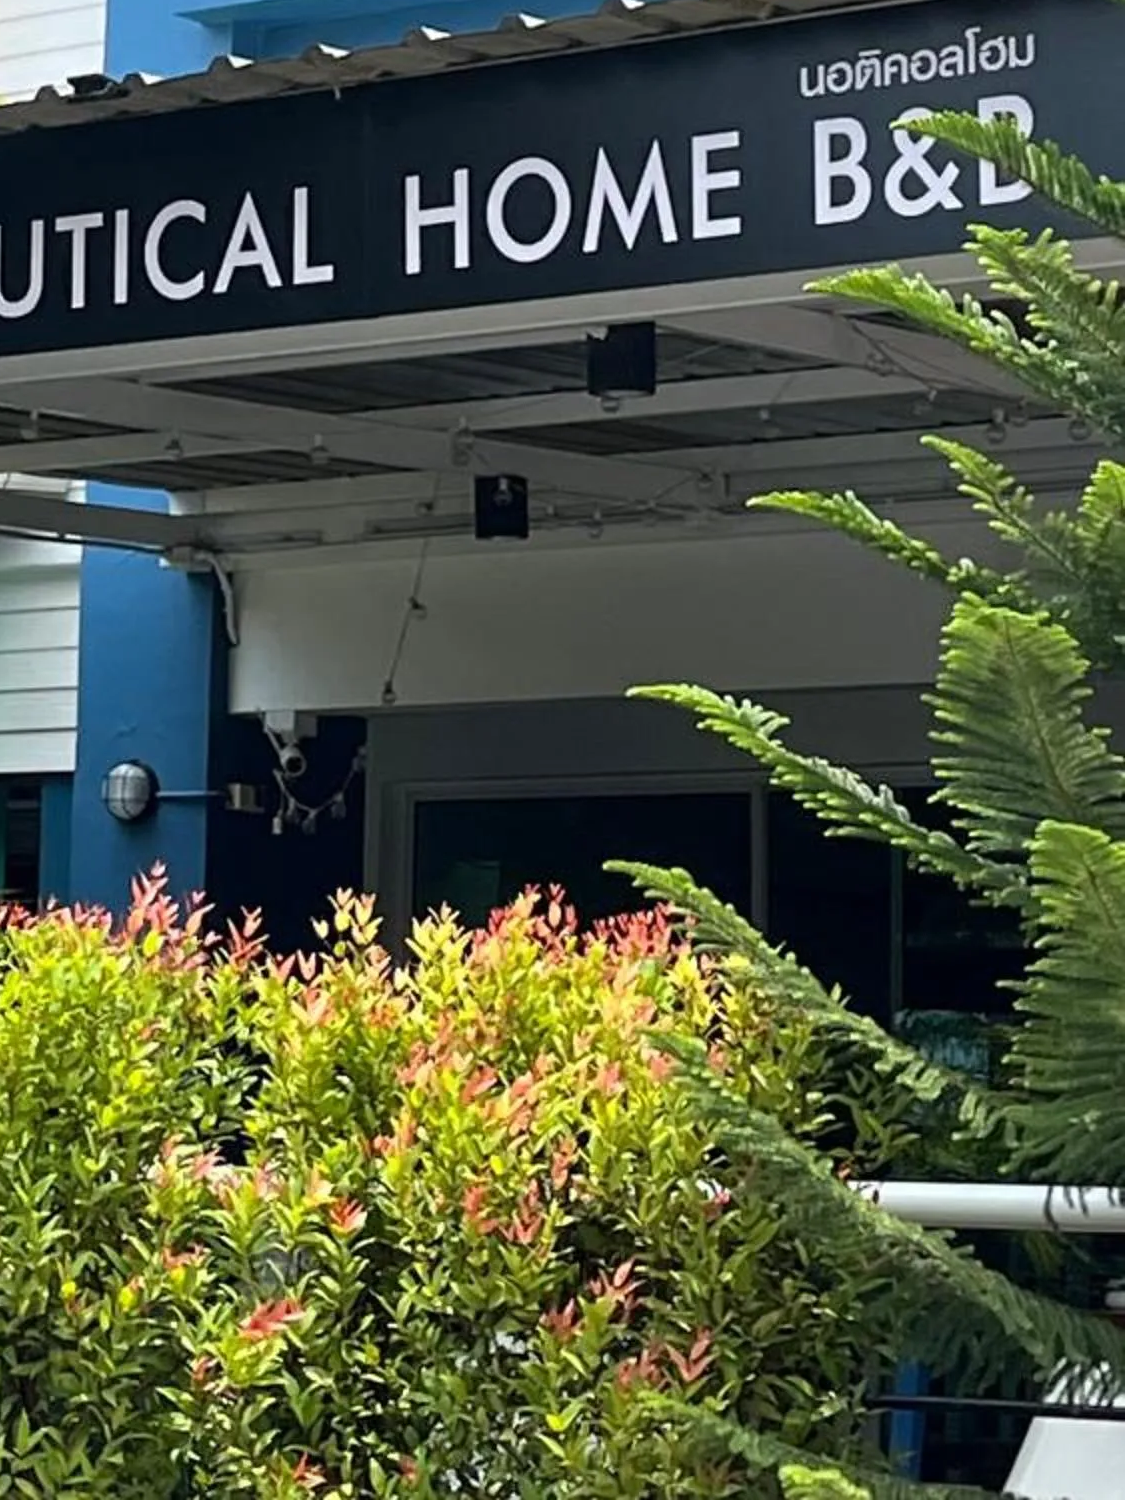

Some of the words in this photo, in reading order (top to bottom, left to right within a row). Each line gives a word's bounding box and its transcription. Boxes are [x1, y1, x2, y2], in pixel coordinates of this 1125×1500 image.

[799, 28, 1036, 98] นอติคอลโฮม
[404, 129, 742, 276] HOME
